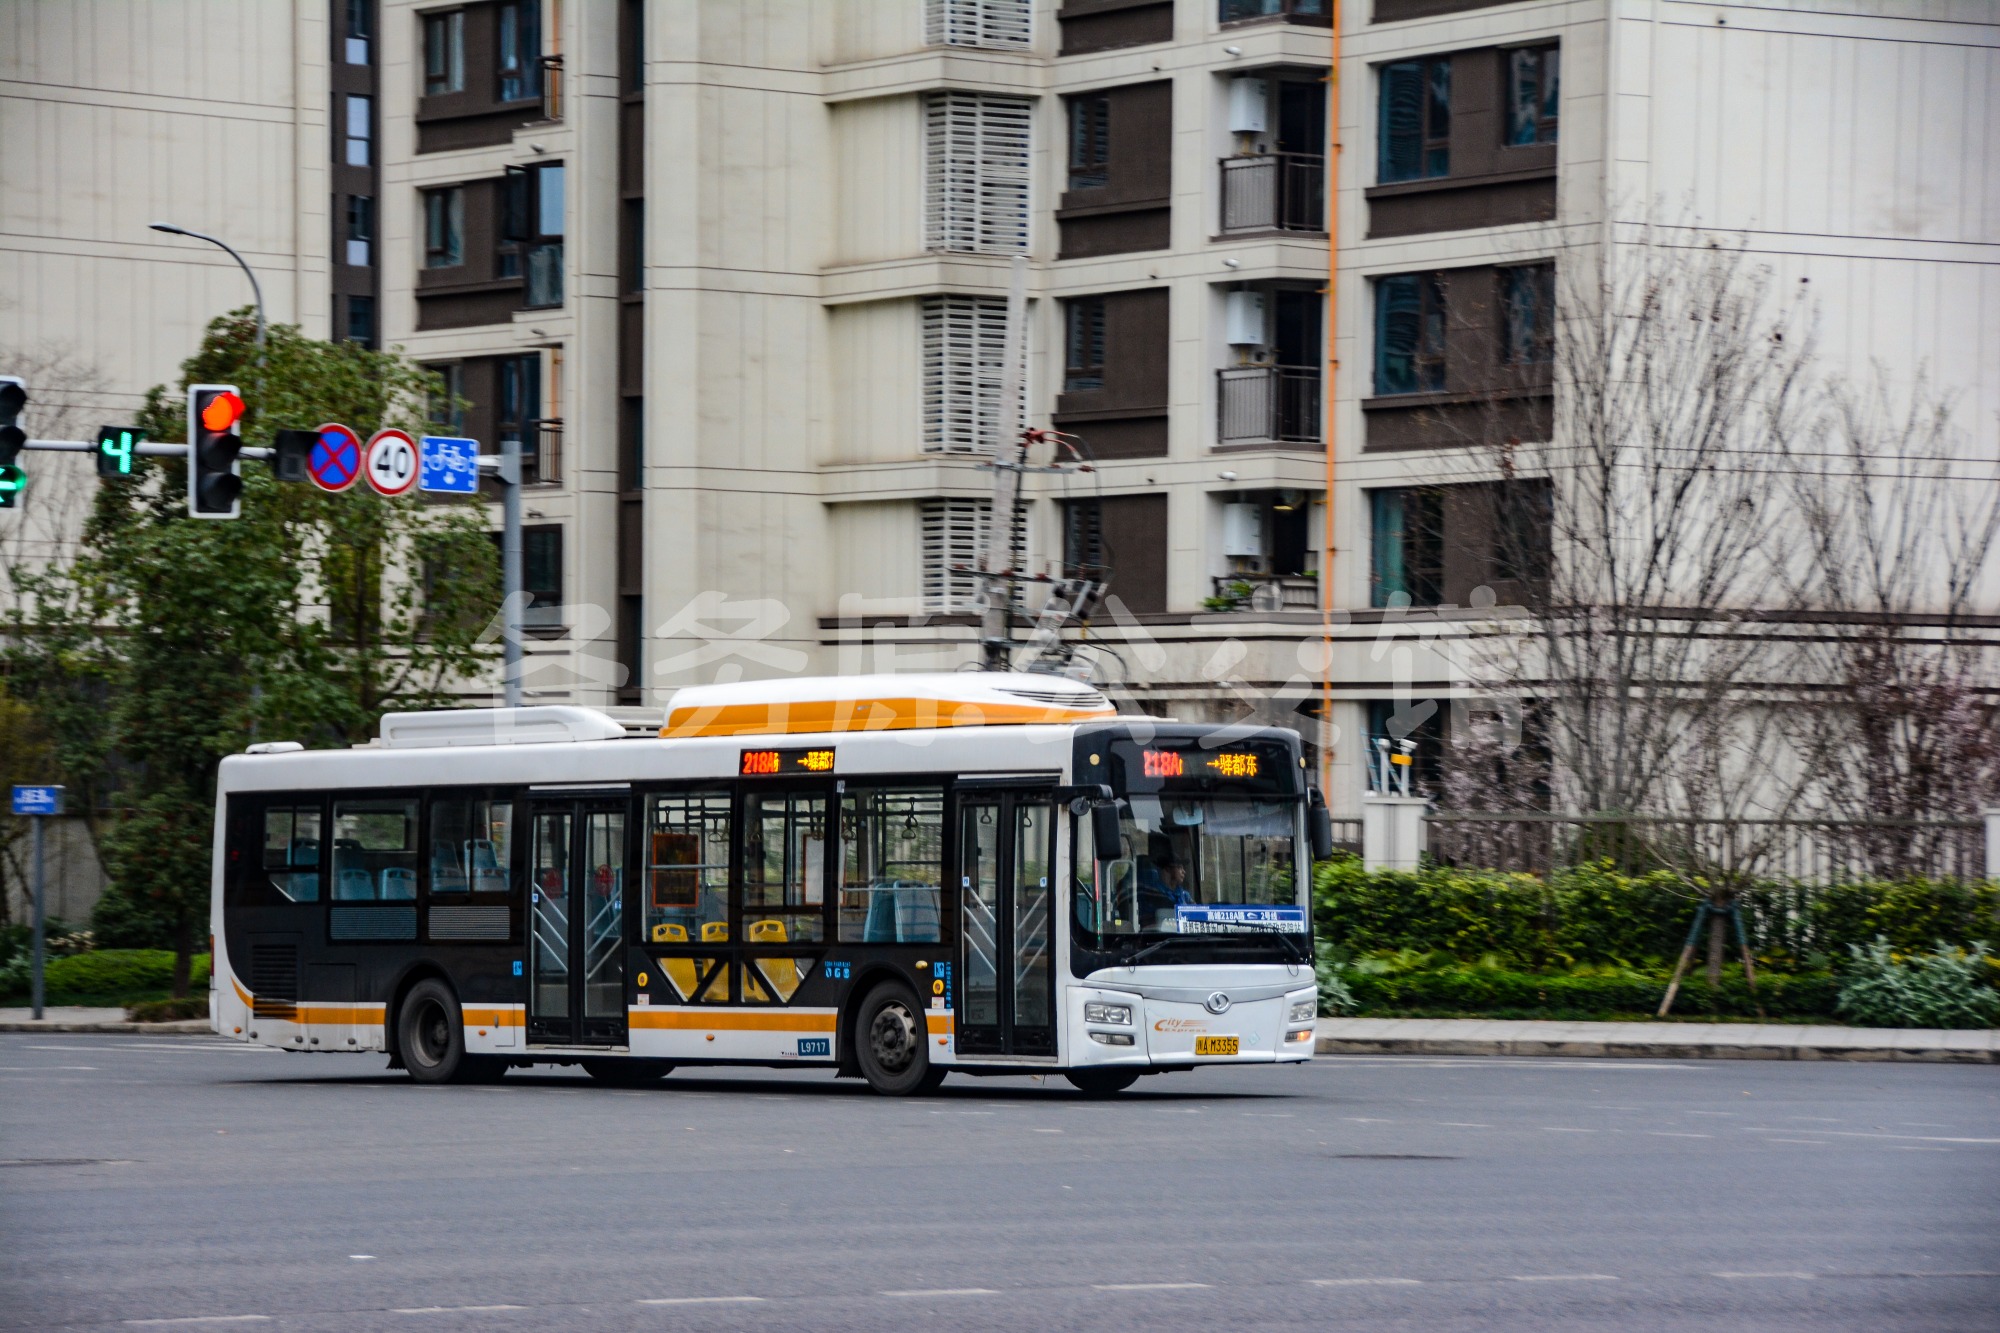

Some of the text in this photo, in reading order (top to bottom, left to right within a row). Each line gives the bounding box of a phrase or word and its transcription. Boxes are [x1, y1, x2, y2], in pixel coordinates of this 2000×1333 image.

[102, 431, 131, 474] 4
[375, 445, 408, 480] 40
[1219, 753, 1258, 776] 驿都东
[800, 1041, 826, 1053] L9717
